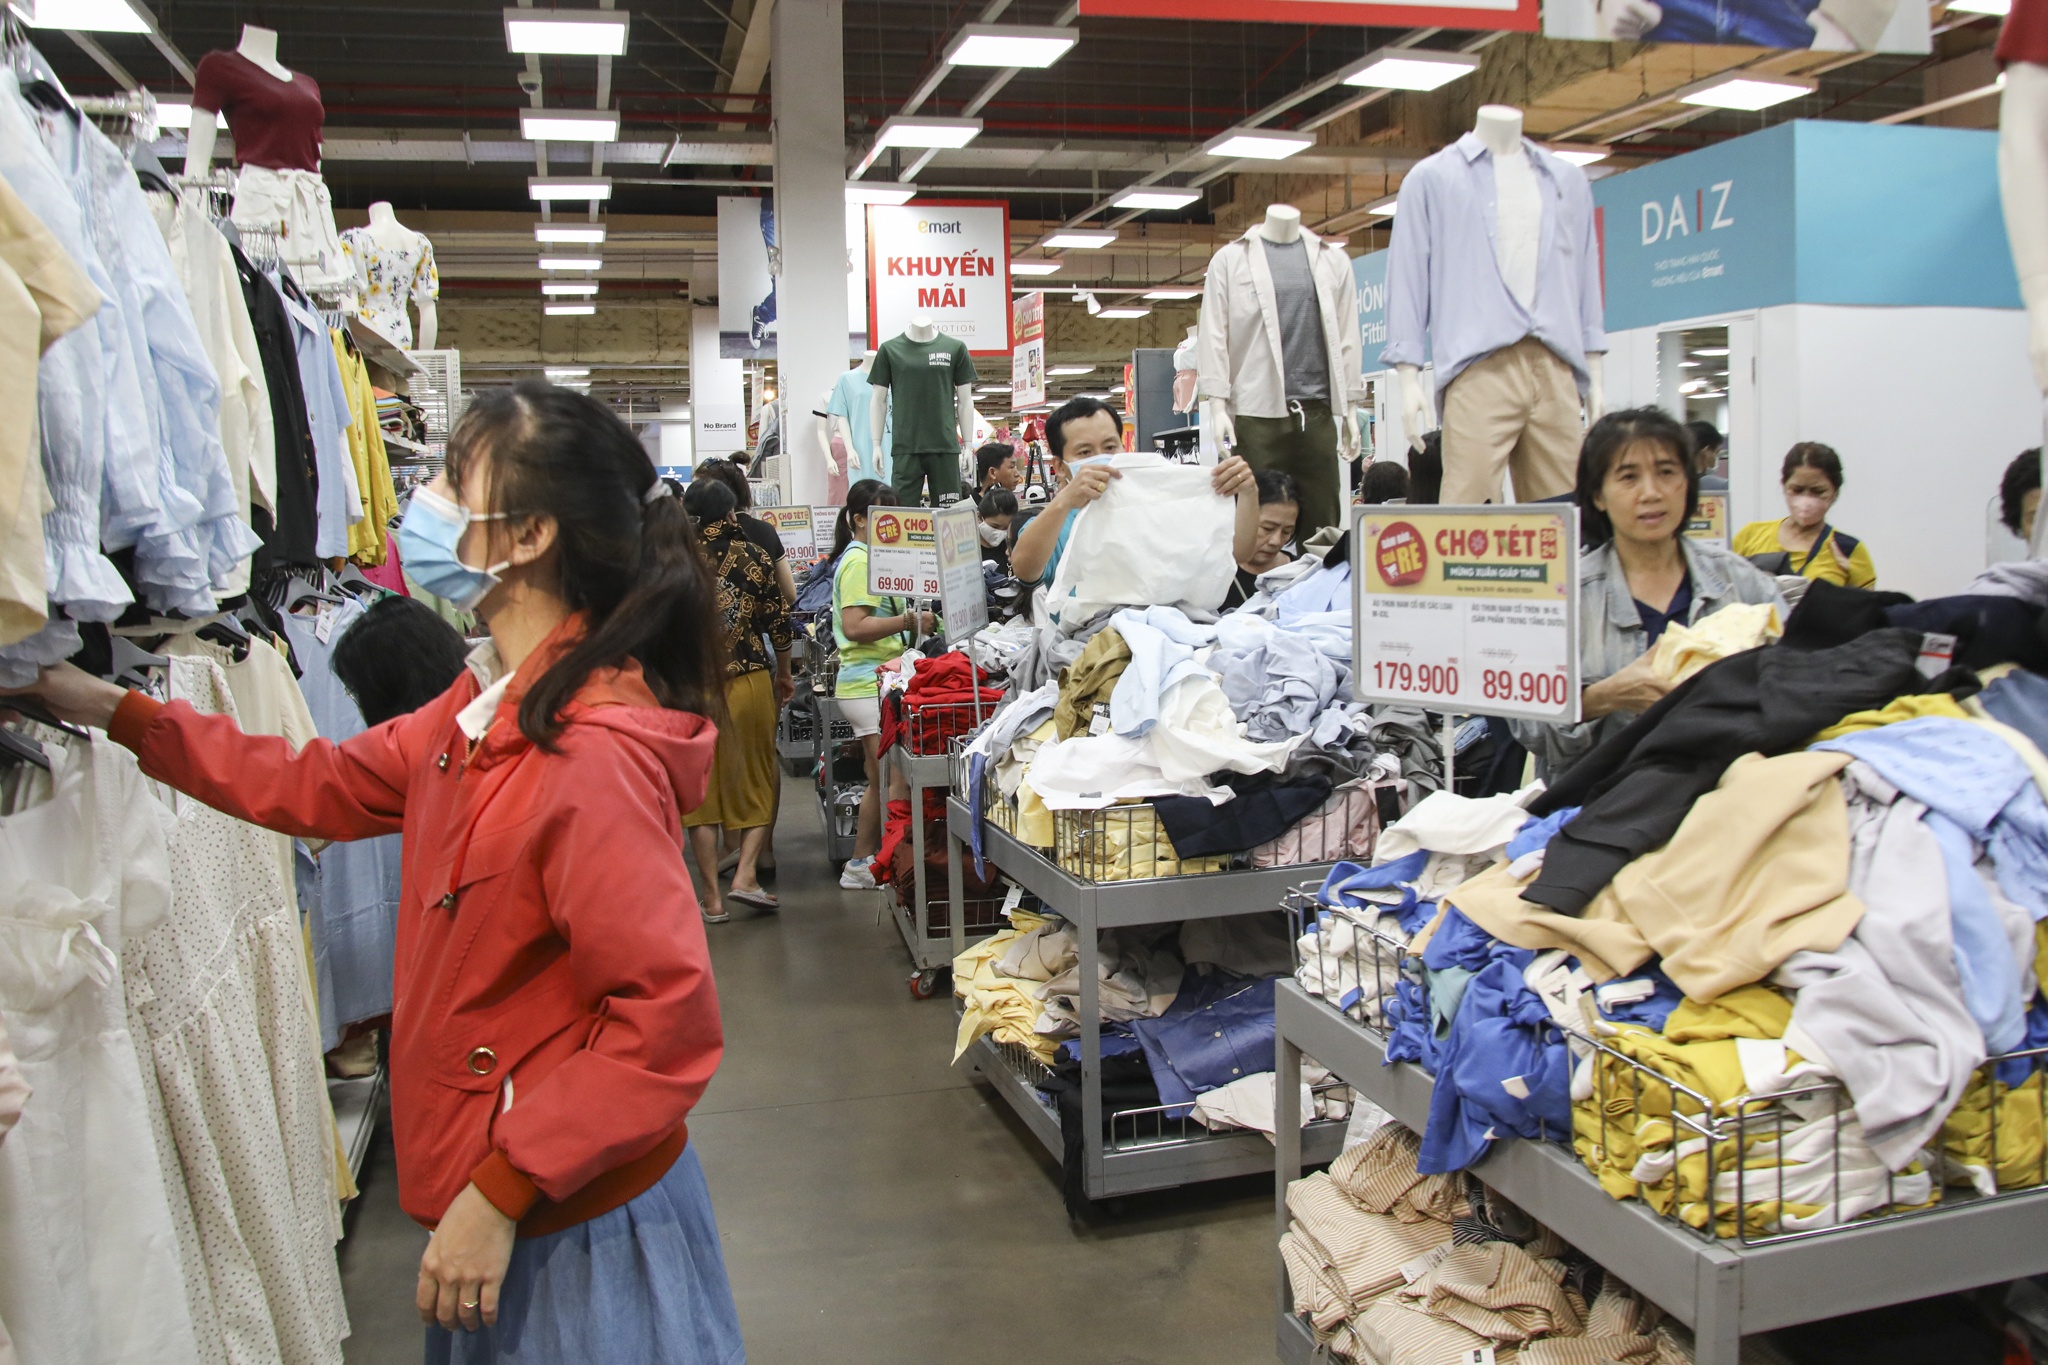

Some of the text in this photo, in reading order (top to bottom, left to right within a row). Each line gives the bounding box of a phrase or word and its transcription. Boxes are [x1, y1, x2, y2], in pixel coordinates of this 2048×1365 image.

[887, 248, 994, 276] KHUYẾN
[917, 282, 966, 308] MÃI
[1435, 529, 1488, 560] CHỢ
[1493, 525, 1536, 557] TẾT
[878, 576, 914, 592] 69.900
[923, 579, 940, 594] 59.
[1374, 661, 1459, 695] 179.900
[1483, 669, 1567, 705] 89.900
